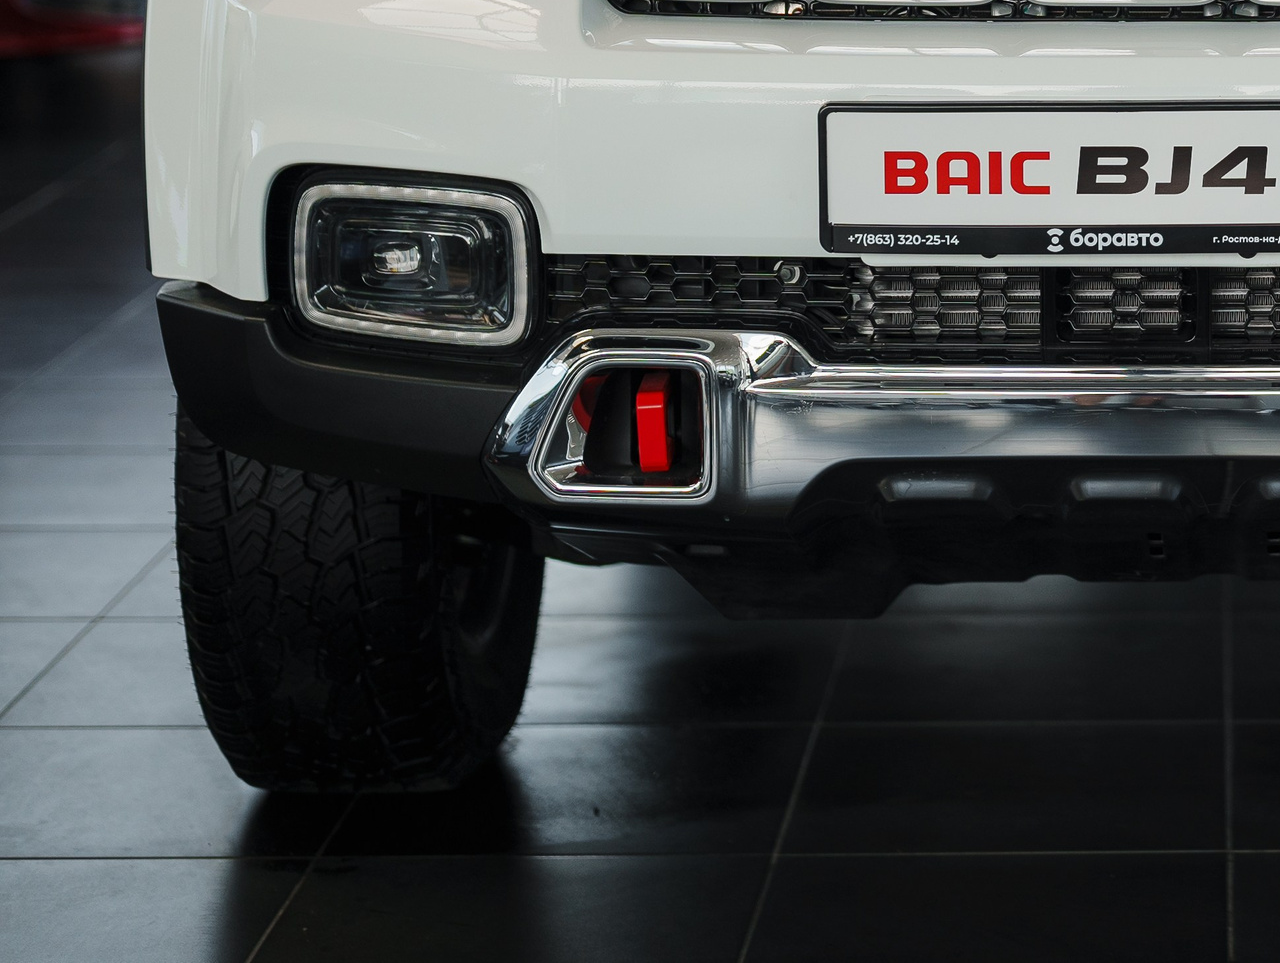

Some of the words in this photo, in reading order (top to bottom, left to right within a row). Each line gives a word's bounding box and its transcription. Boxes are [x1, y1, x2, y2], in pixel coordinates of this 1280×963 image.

[883, 151, 1050, 195] BAIC
[848, 233, 895, 247] +7(863)
[898, 235, 960, 246] 320-25-14
[1069, 228, 1164, 250] боравто
